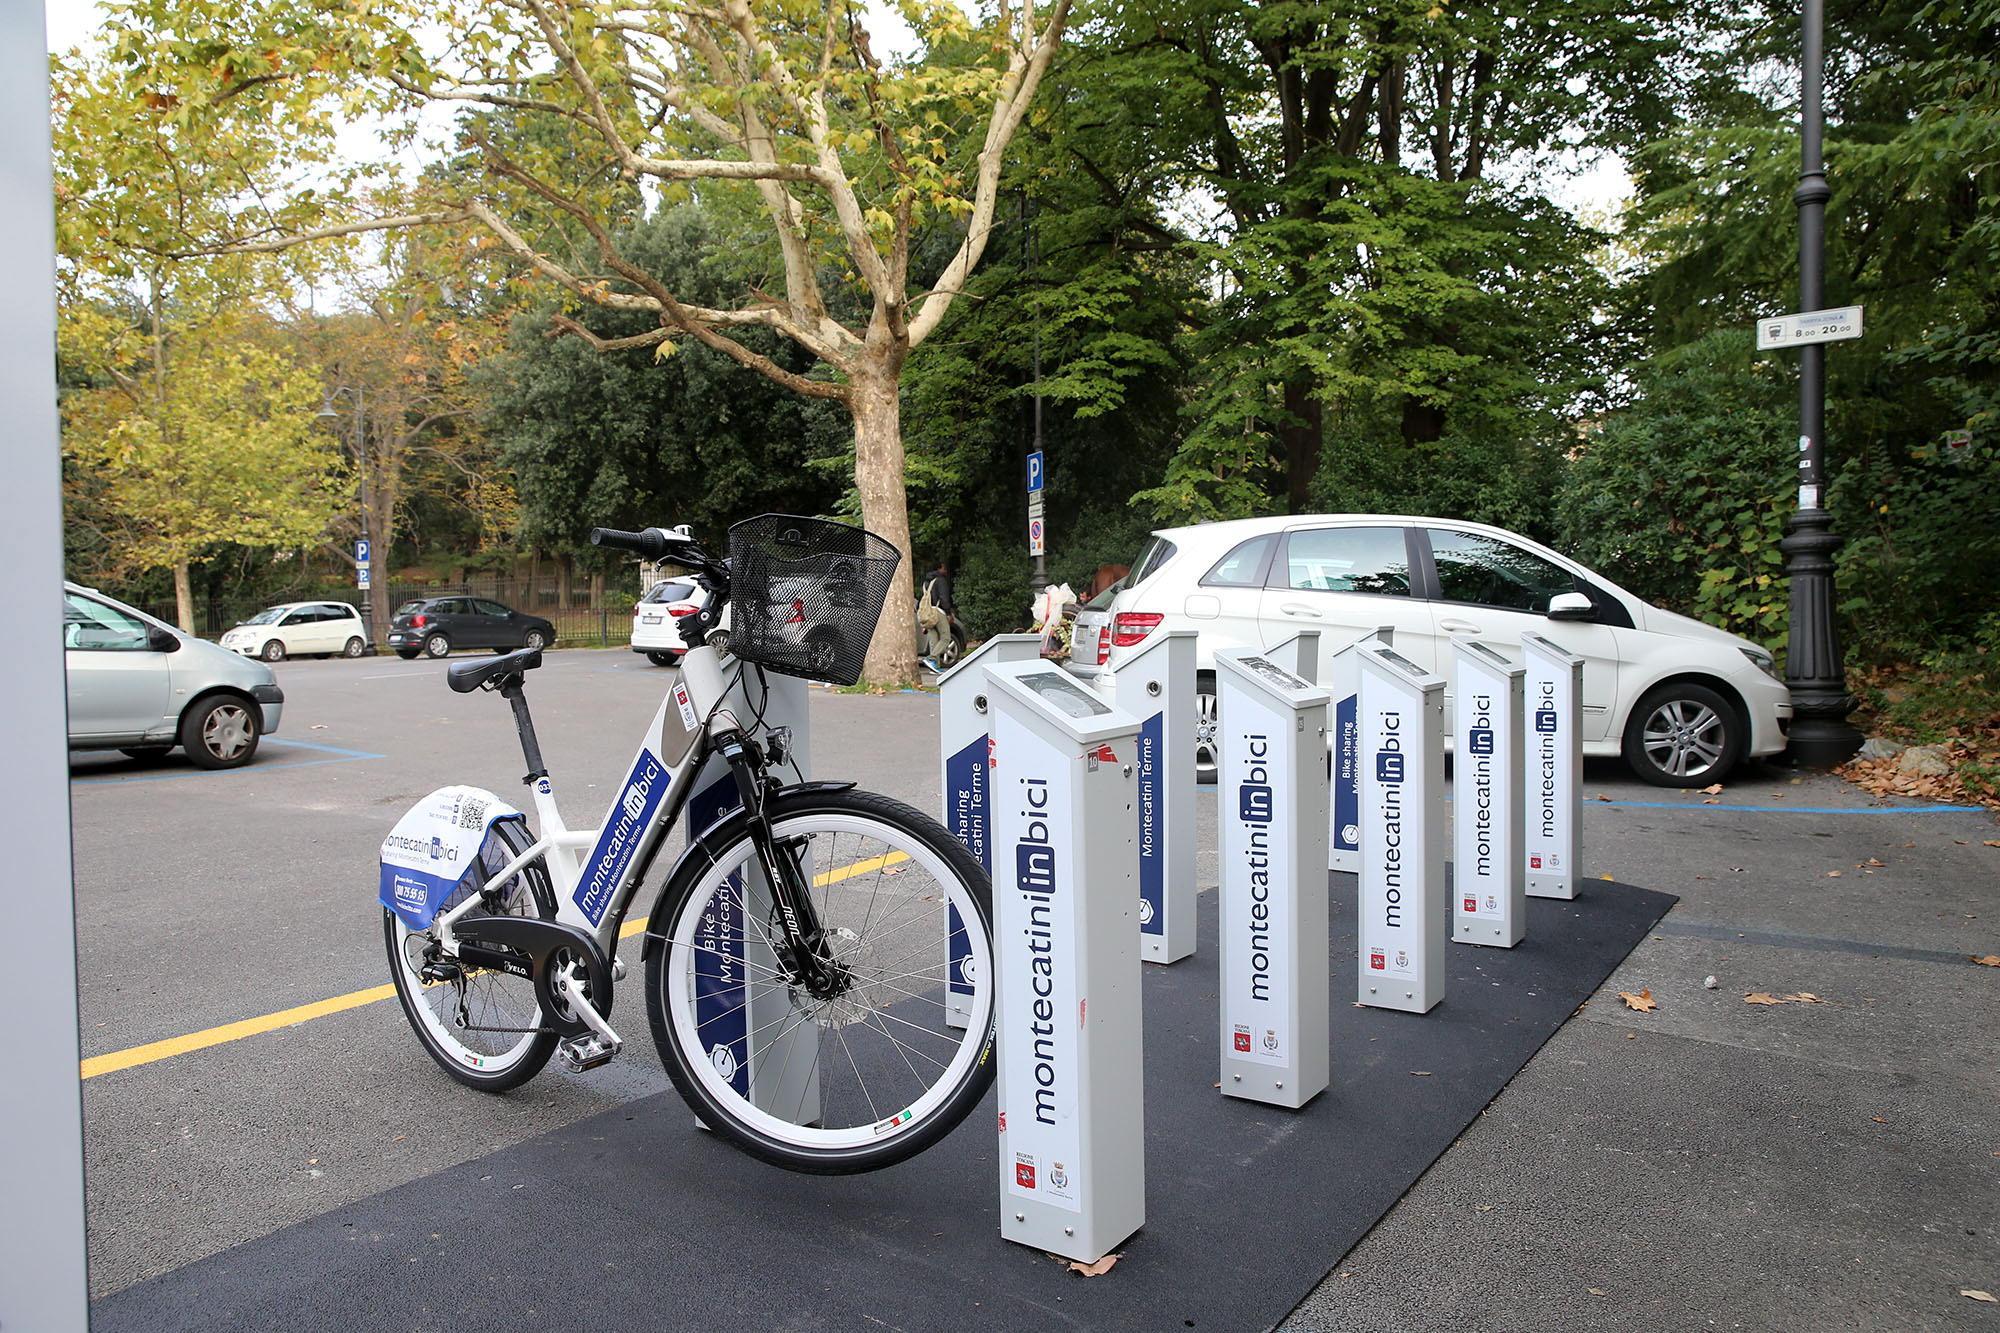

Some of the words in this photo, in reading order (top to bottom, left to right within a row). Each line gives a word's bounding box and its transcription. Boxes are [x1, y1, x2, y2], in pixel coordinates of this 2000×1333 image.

[1029, 457, 1040, 487] P
[357, 543, 367, 560] P
[1089, 756, 1098, 768] 10
[1141, 737, 1153, 778] Terme
[1342, 721, 1354, 757] sharing
[1342, 759, 1351, 779] Bike
[1536, 681, 1557, 838] montecatiniinbici
[970, 762, 982, 811] Terme
[1470, 695, 1494, 876] montecatiniinbici
[581, 758, 660, 912] montecatiniinbici
[1141, 782, 1153, 857] Montecatini
[1377, 711, 1405, 928] montecatiniinbici
[591, 905, 601, 921] Bike
[599, 879, 615, 909] sharing
[611, 845, 633, 885] Montecatini
[628, 824, 643, 847] Terme
[1240, 735, 1273, 1002] montecatiniinbici
[703, 913, 717, 951] Bike
[1016, 778, 1056, 1126] montecatiniinbici
